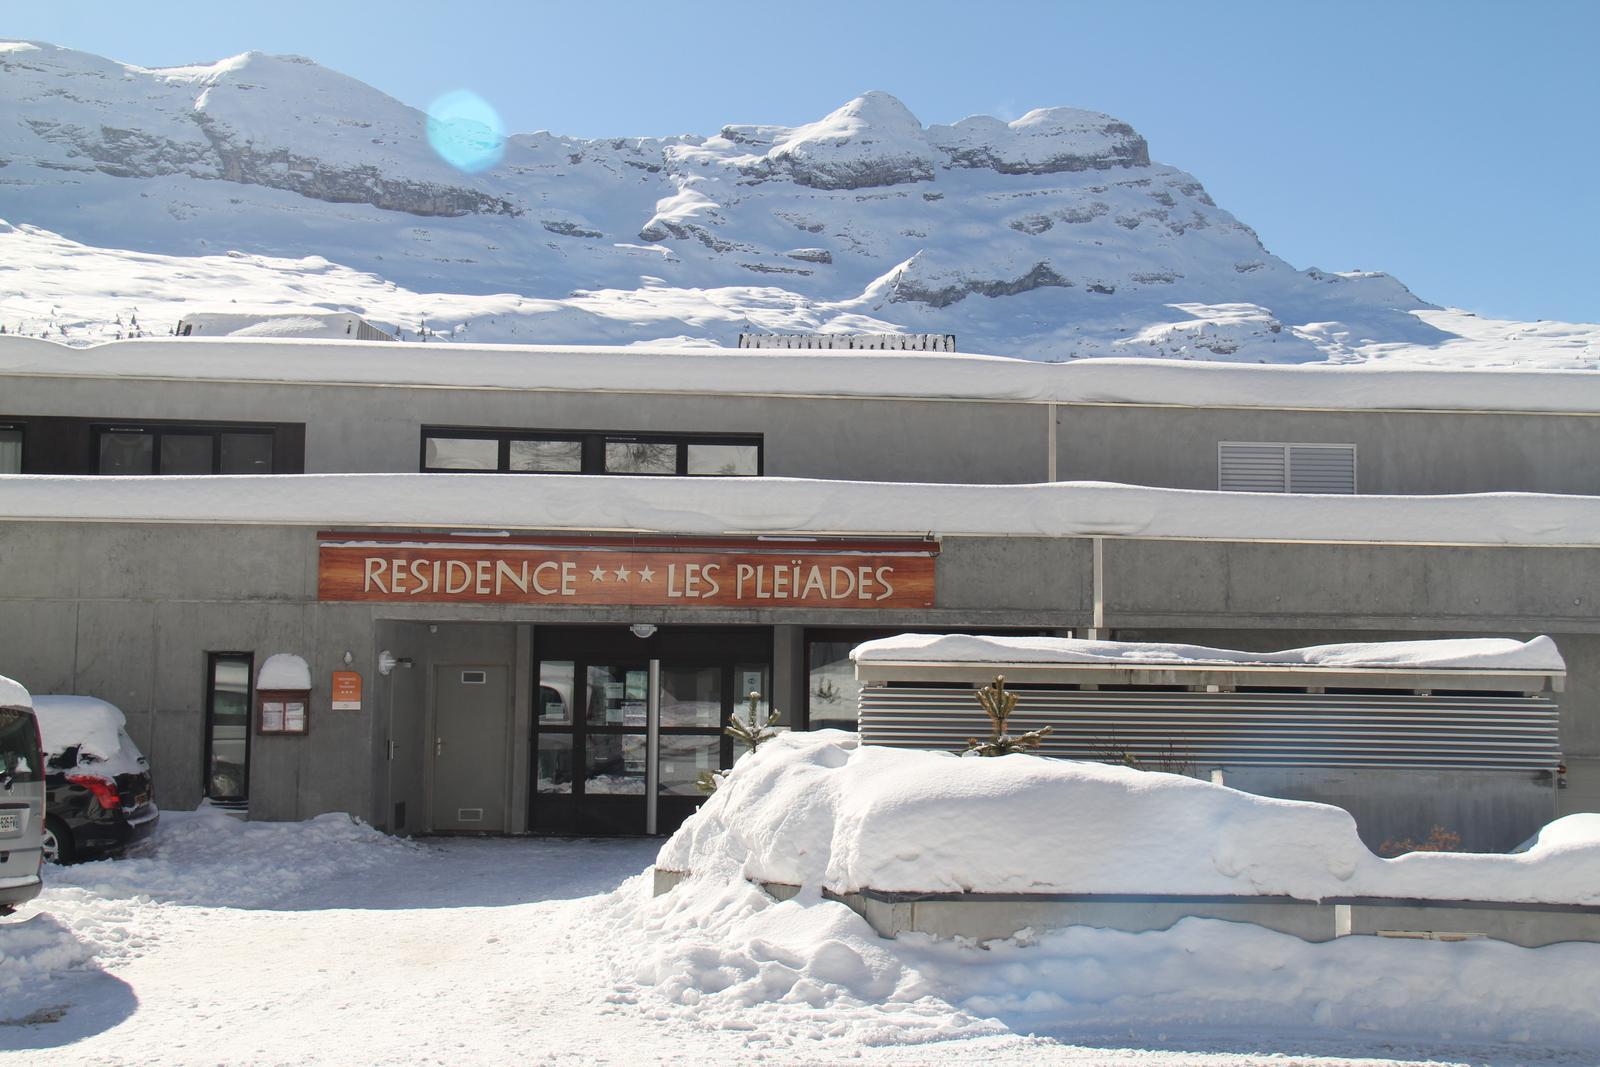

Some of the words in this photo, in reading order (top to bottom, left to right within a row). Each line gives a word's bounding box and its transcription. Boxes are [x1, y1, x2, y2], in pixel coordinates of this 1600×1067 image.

[364, 557, 577, 596] RESIDENCE
[667, 562, 720, 600] LES
[736, 559, 894, 602] PLEÏADES
